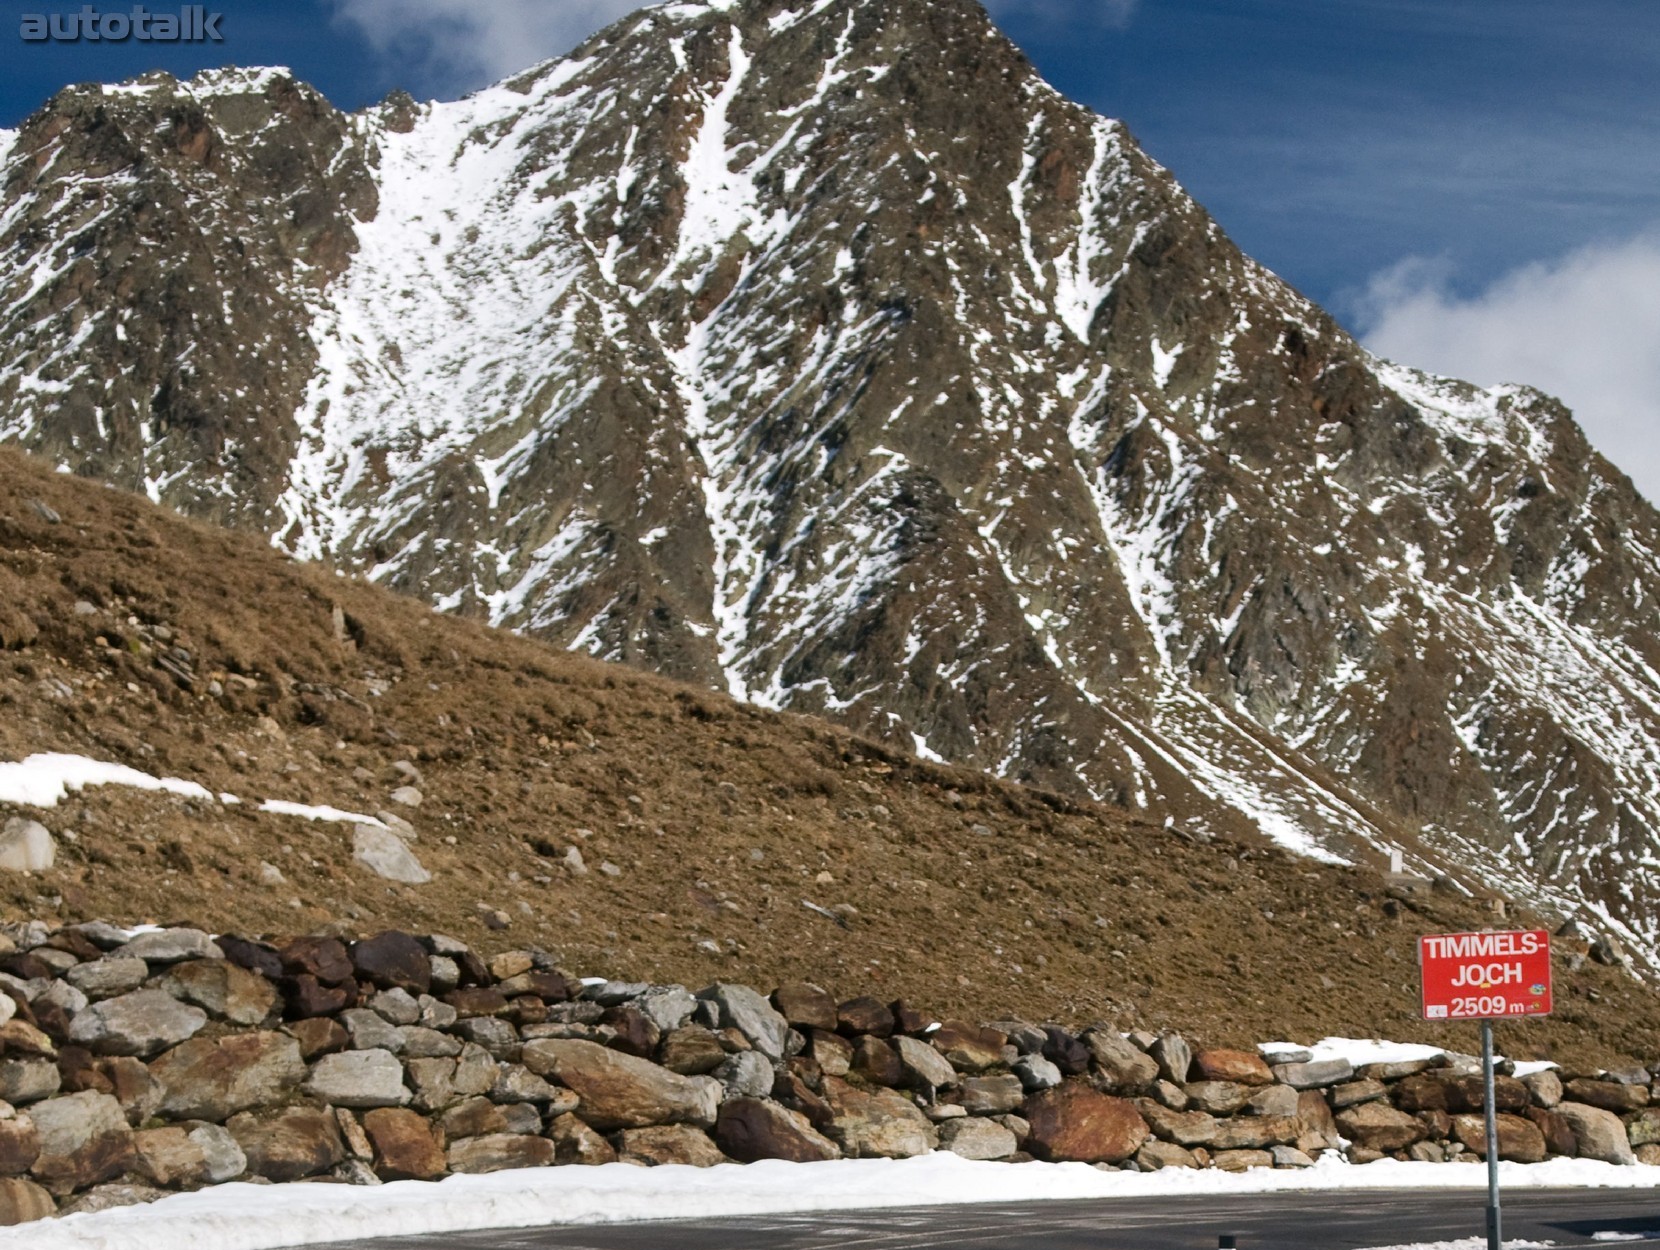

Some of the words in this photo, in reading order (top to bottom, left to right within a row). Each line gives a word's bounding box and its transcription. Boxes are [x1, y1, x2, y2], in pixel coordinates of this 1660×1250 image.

[1424, 933, 1547, 959] TIMMELS-
[1451, 962, 1523, 987] JOCH
[1451, 996, 1506, 1017] 2509
[1509, 1002, 1525, 1014] m
